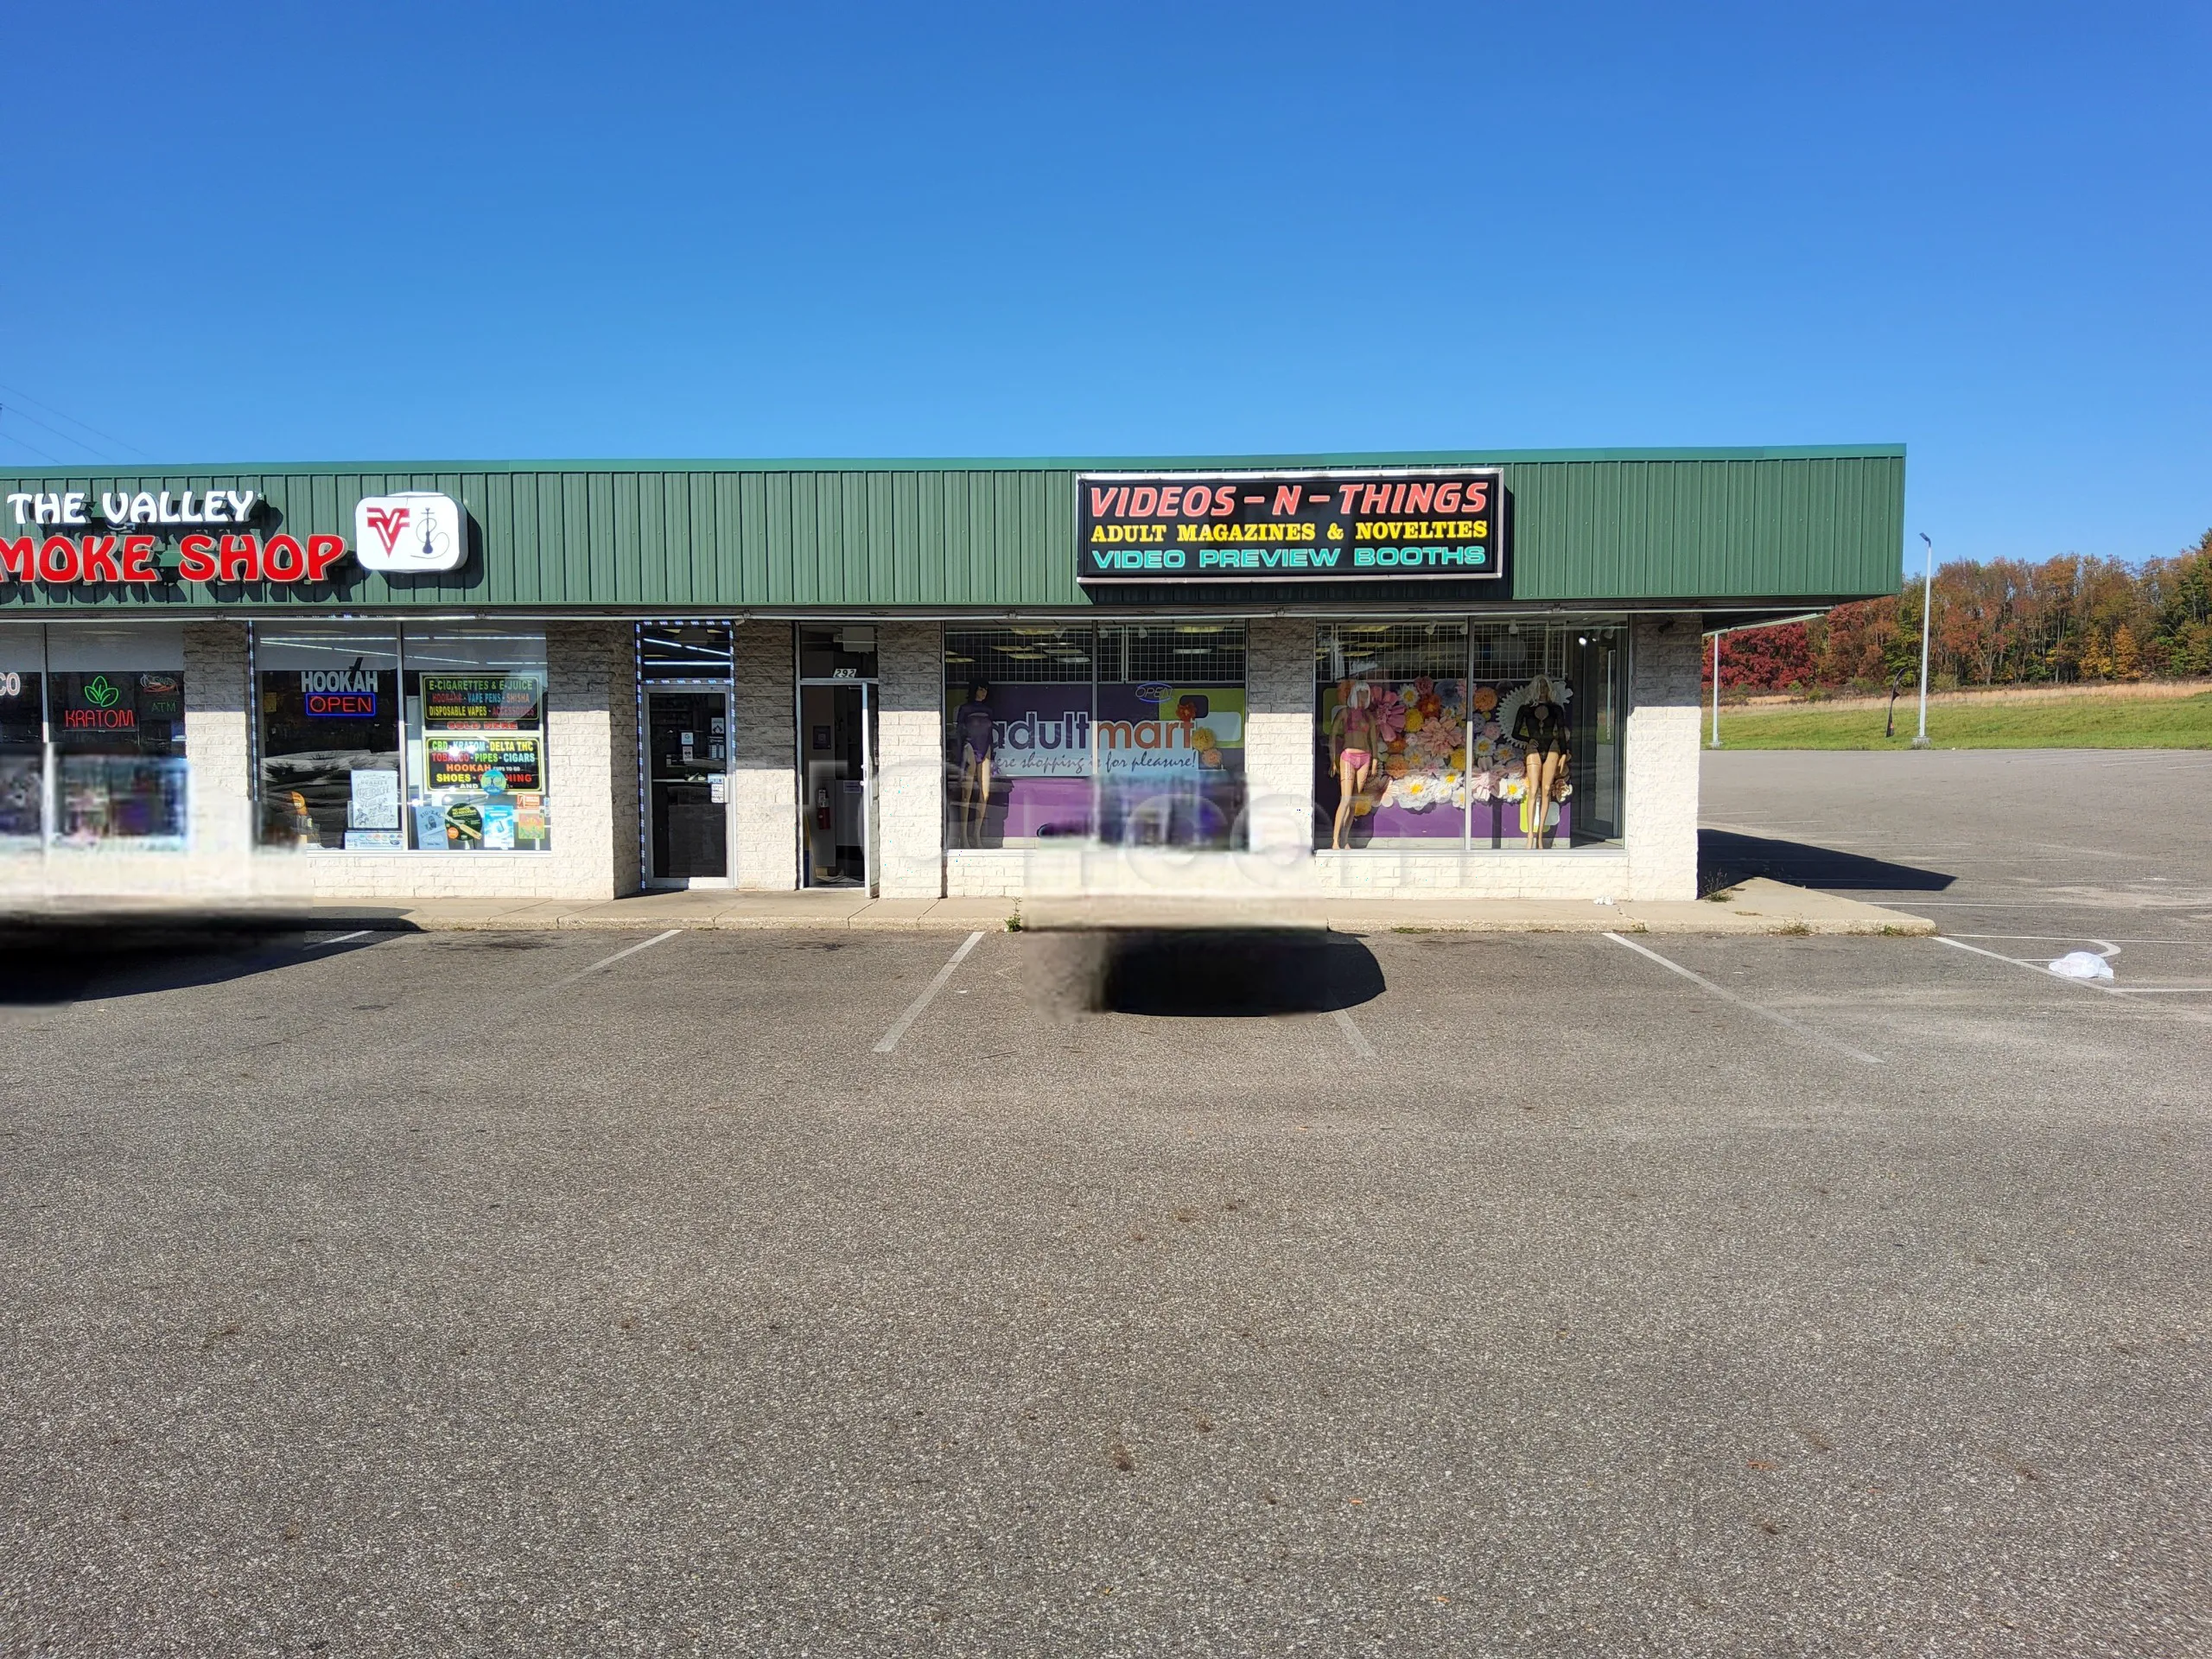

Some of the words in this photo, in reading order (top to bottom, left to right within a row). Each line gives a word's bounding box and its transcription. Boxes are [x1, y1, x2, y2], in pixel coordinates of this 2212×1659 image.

[1090, 486, 1236, 517] VIDEOS
[1339, 481, 1490, 513] THINGS
[6, 493, 87, 525] THE
[101, 490, 252, 524] VALLEY
[1090, 524, 1167, 543] ADULT
[1177, 523, 1317, 542] MAGAZINES
[1326, 523, 1344, 540] &
[1356, 520, 1489, 539] NOVELTIES
[0, 534, 159, 582] MOKE
[178, 534, 346, 582] SHOP
[1092, 549, 1186, 569] VIDEO
[1199, 548, 1342, 568] PREVIEW
[1354, 545, 1486, 566] BOOTHS
[835, 669, 855, 677] 292
[301, 671, 378, 693] HOOKAH
[429, 679, 489, 690] E-CIGARETTES
[491, 680, 497, 690] &
[499, 679, 533, 690] E-JUICE
[467, 692, 484, 703] VAPE
[485, 692, 502, 703] PENS
[505, 692, 530, 703] SHISHA
[1135, 687, 1173, 700] OPEN
[150, 701, 176, 714] ATM
[310, 696, 372, 713] OPEN
[429, 705, 466, 716] DISPOSABLE
[467, 705, 487, 716] VAPES
[65, 709, 136, 728] KRATOM
[447, 721, 481, 730] SOLD
[483, 721, 518, 730] HERE
[432, 741, 448, 751] CBD
[453, 741, 486, 752] KRATOM
[489, 741, 515, 752] DELTA
[517, 741, 534, 752] THC
[474, 753, 499, 762] PIPES
[503, 753, 536, 763] CIGARS
[1020, 751, 1084, 775] shopping
[1105, 751, 1128, 774] for
[1131, 750, 1198, 775] pleasure!
[436, 773, 471, 782] SHOES
